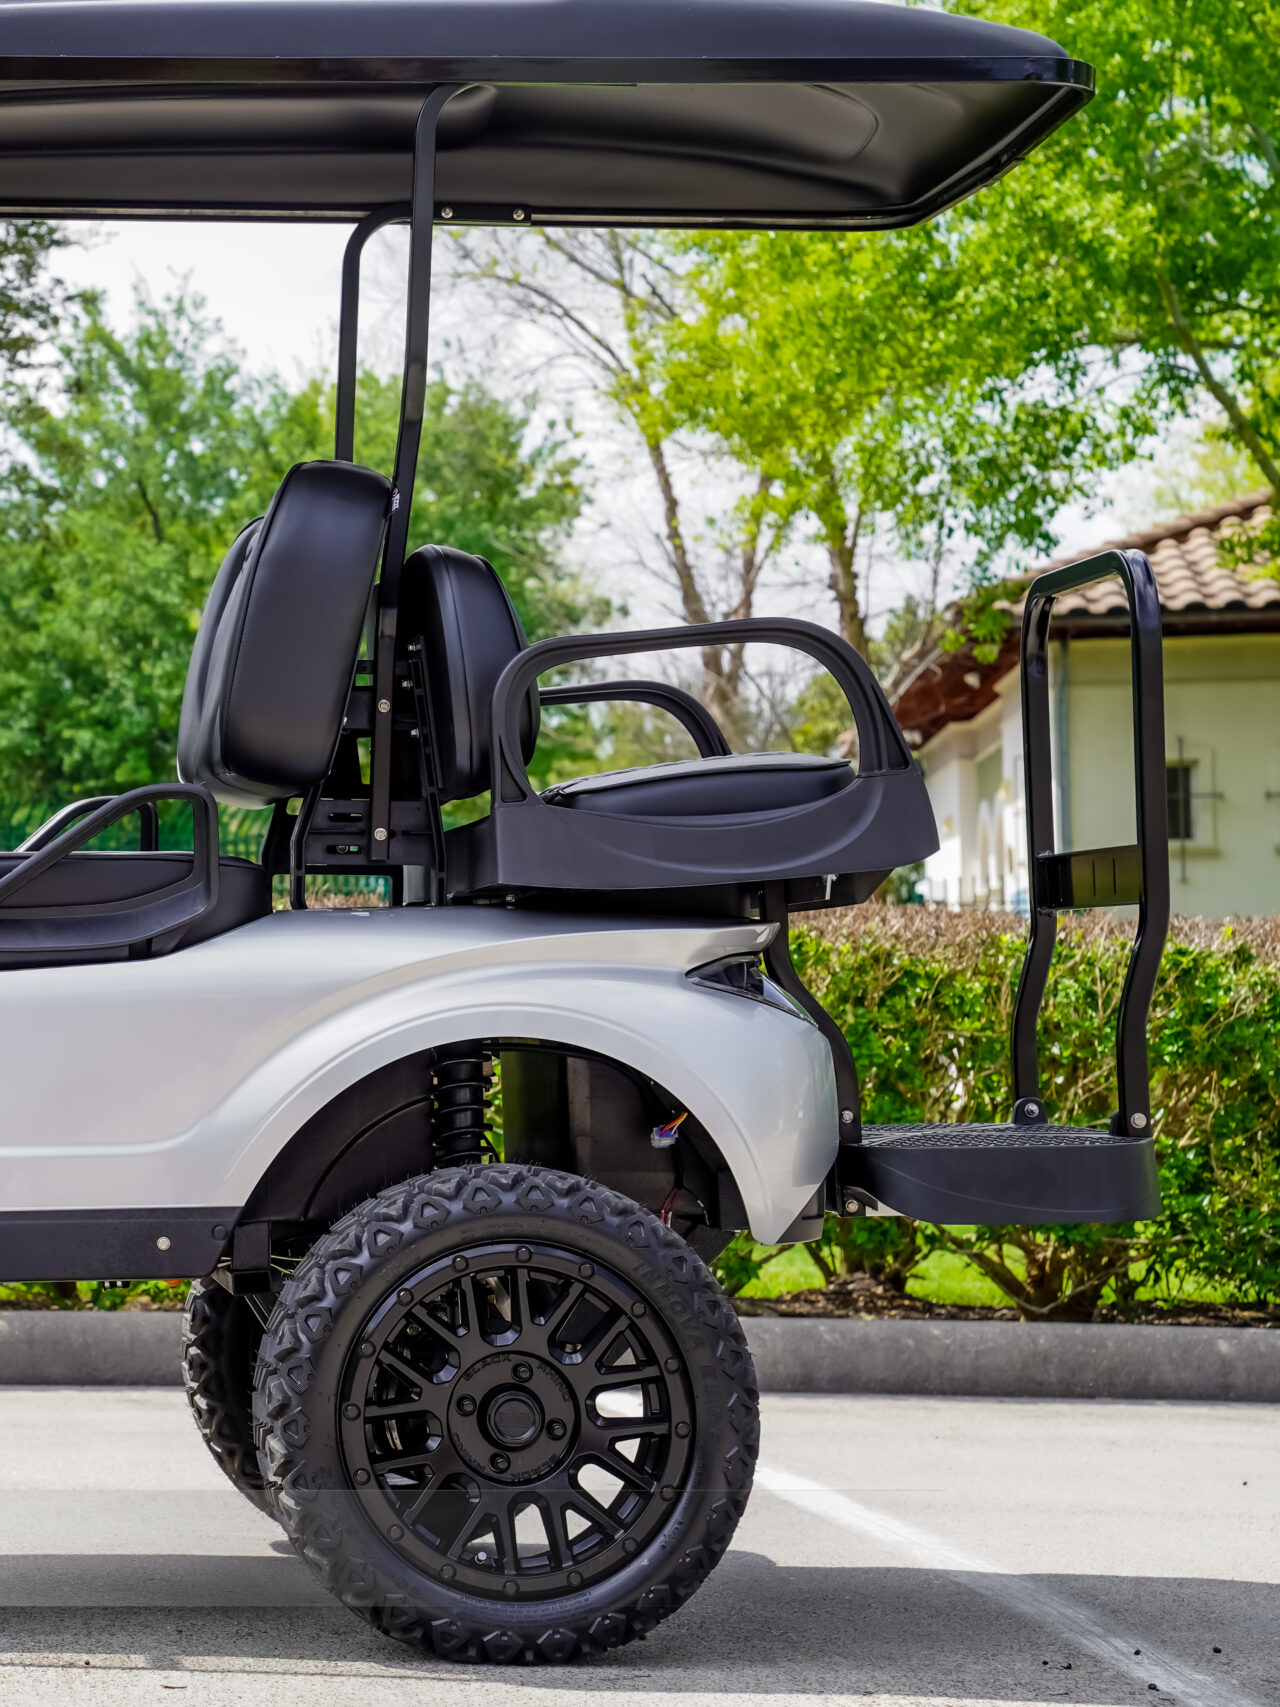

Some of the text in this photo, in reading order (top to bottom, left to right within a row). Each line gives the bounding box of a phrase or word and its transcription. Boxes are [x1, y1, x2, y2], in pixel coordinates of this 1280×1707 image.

[631, 1262, 706, 1352] INNOVA
[463, 1353, 571, 1402] BLACK RHINO
